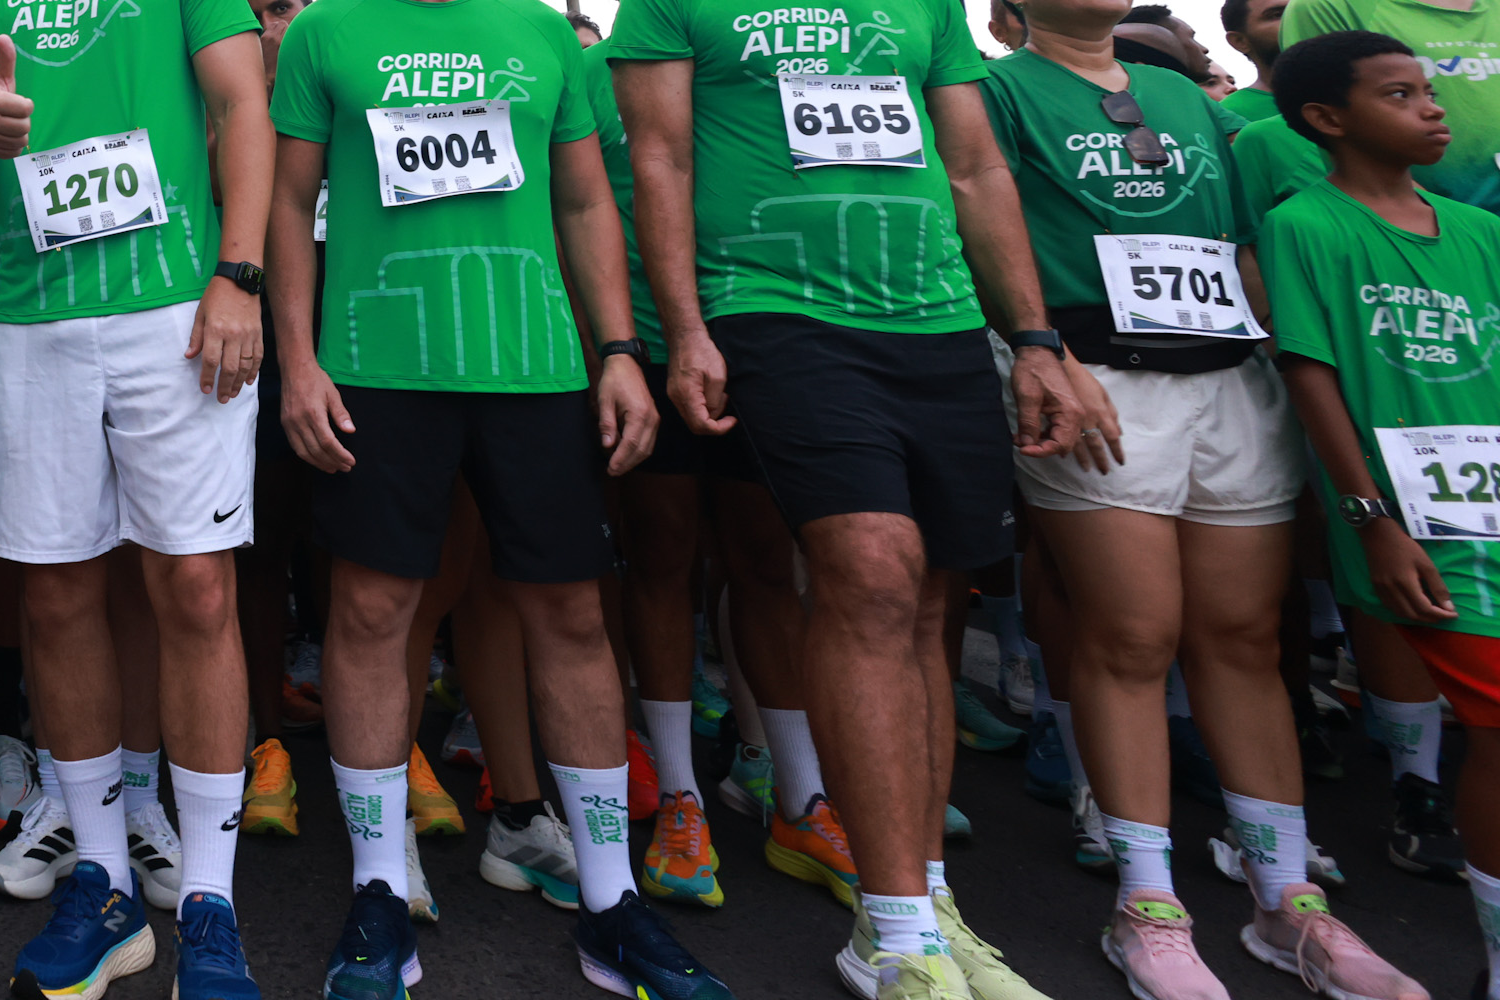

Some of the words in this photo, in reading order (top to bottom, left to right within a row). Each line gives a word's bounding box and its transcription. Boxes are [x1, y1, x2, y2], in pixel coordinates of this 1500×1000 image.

[732, 7, 849, 33] CORRIDA
[36, 29, 80, 49] 2026
[740, 25, 850, 62] ALEPI
[377, 52, 484, 73] CORRIDA
[776, 58, 829, 75] 2026
[381, 71, 486, 102] ALEPI
[792, 90, 805, 98] 5K
[830, 83, 861, 91] CAIXA
[869, 84, 898, 92] BRASIL
[426, 111, 454, 120] CAIXA
[462, 107, 487, 116] BRASIL
[793, 102, 911, 136] 6165
[71, 146, 97, 158] CAIXA
[104, 140, 128, 150] BRASIL
[396, 129, 497, 173] 6004
[39, 167, 55, 177] 10K
[43, 162, 139, 217] 1270
[1113, 180, 1166, 198] 2026
[1168, 243, 1196, 252] CAIXA
[1130, 265, 1235, 307] 5701
[1360, 283, 1472, 315] CORRIDA
[1369, 306, 1479, 346] ALEPI
[1403, 342, 1458, 365] 2026
[1413, 447, 1439, 455] 10K
[346, 791, 367, 824] ALEPI
[367, 794, 383, 825] CORRIDA
[583, 809, 605, 845] CORRIDA
[598, 809, 623, 843] ALEPI
